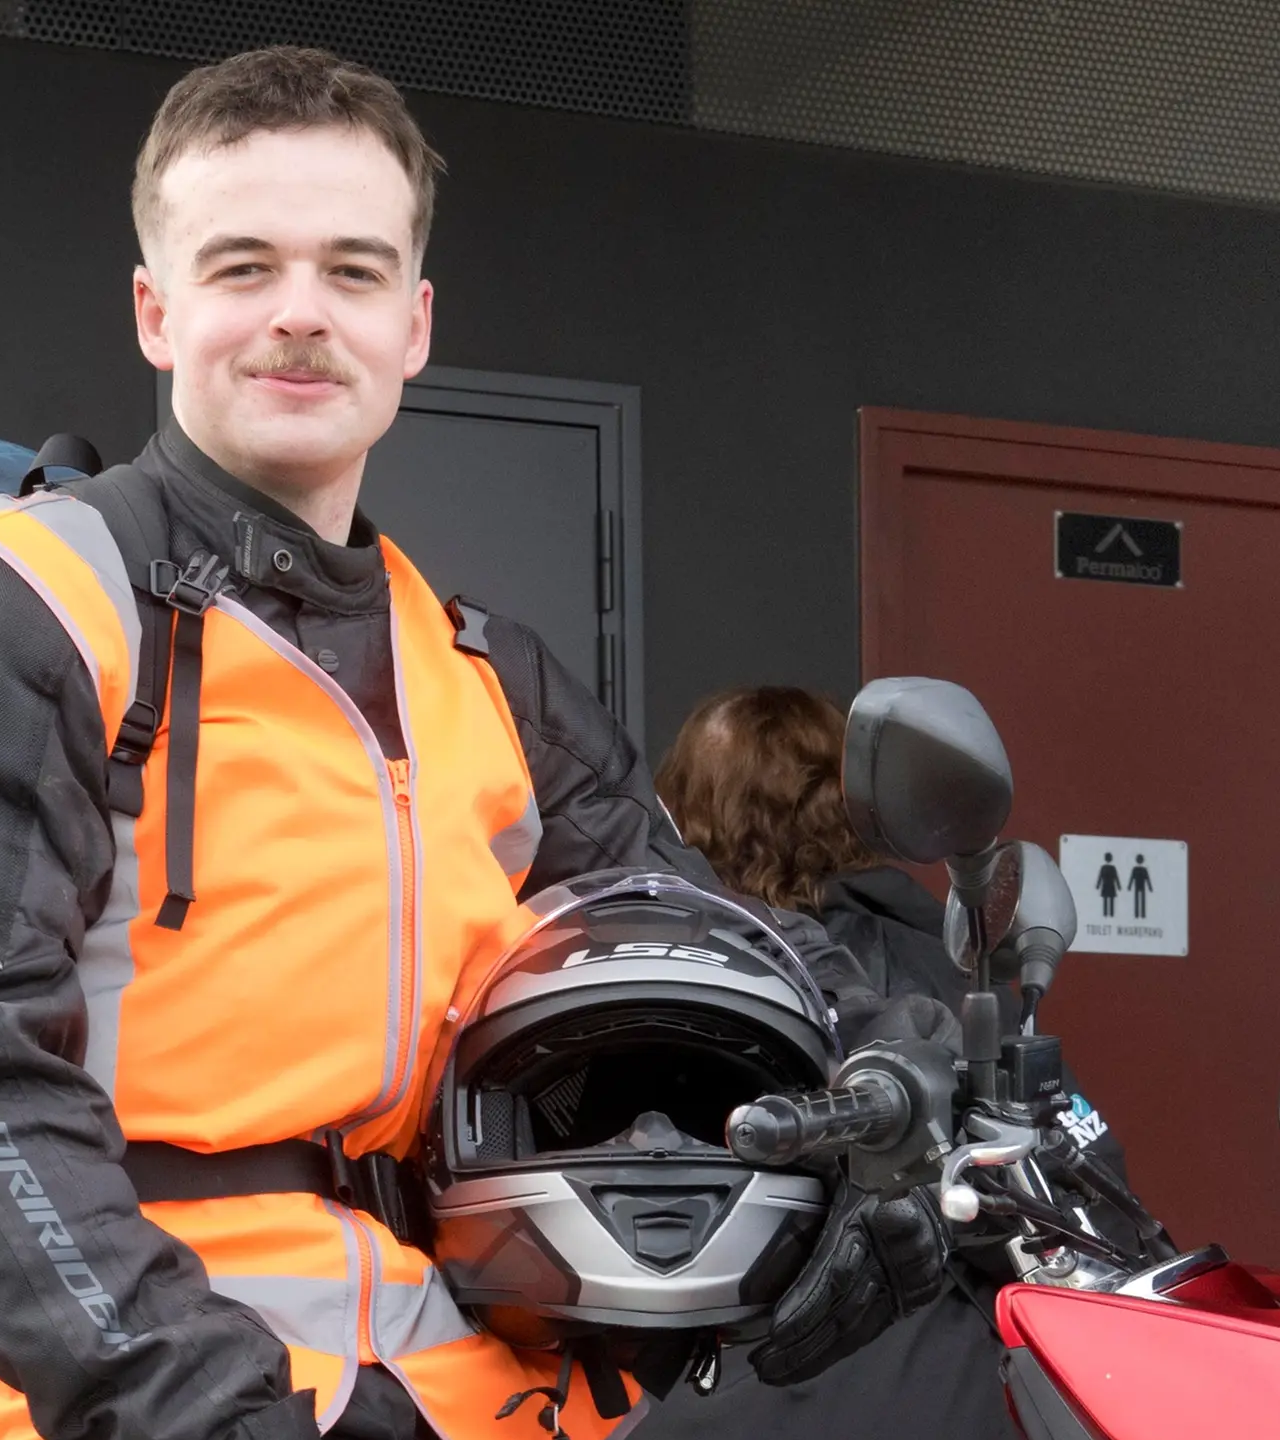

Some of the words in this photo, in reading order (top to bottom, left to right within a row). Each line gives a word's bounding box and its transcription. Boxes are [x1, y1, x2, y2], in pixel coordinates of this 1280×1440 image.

[1084, 924, 1112, 936] TOILET
[561, 942, 730, 969] LS2
[1067, 1109, 1109, 1149] NZ
